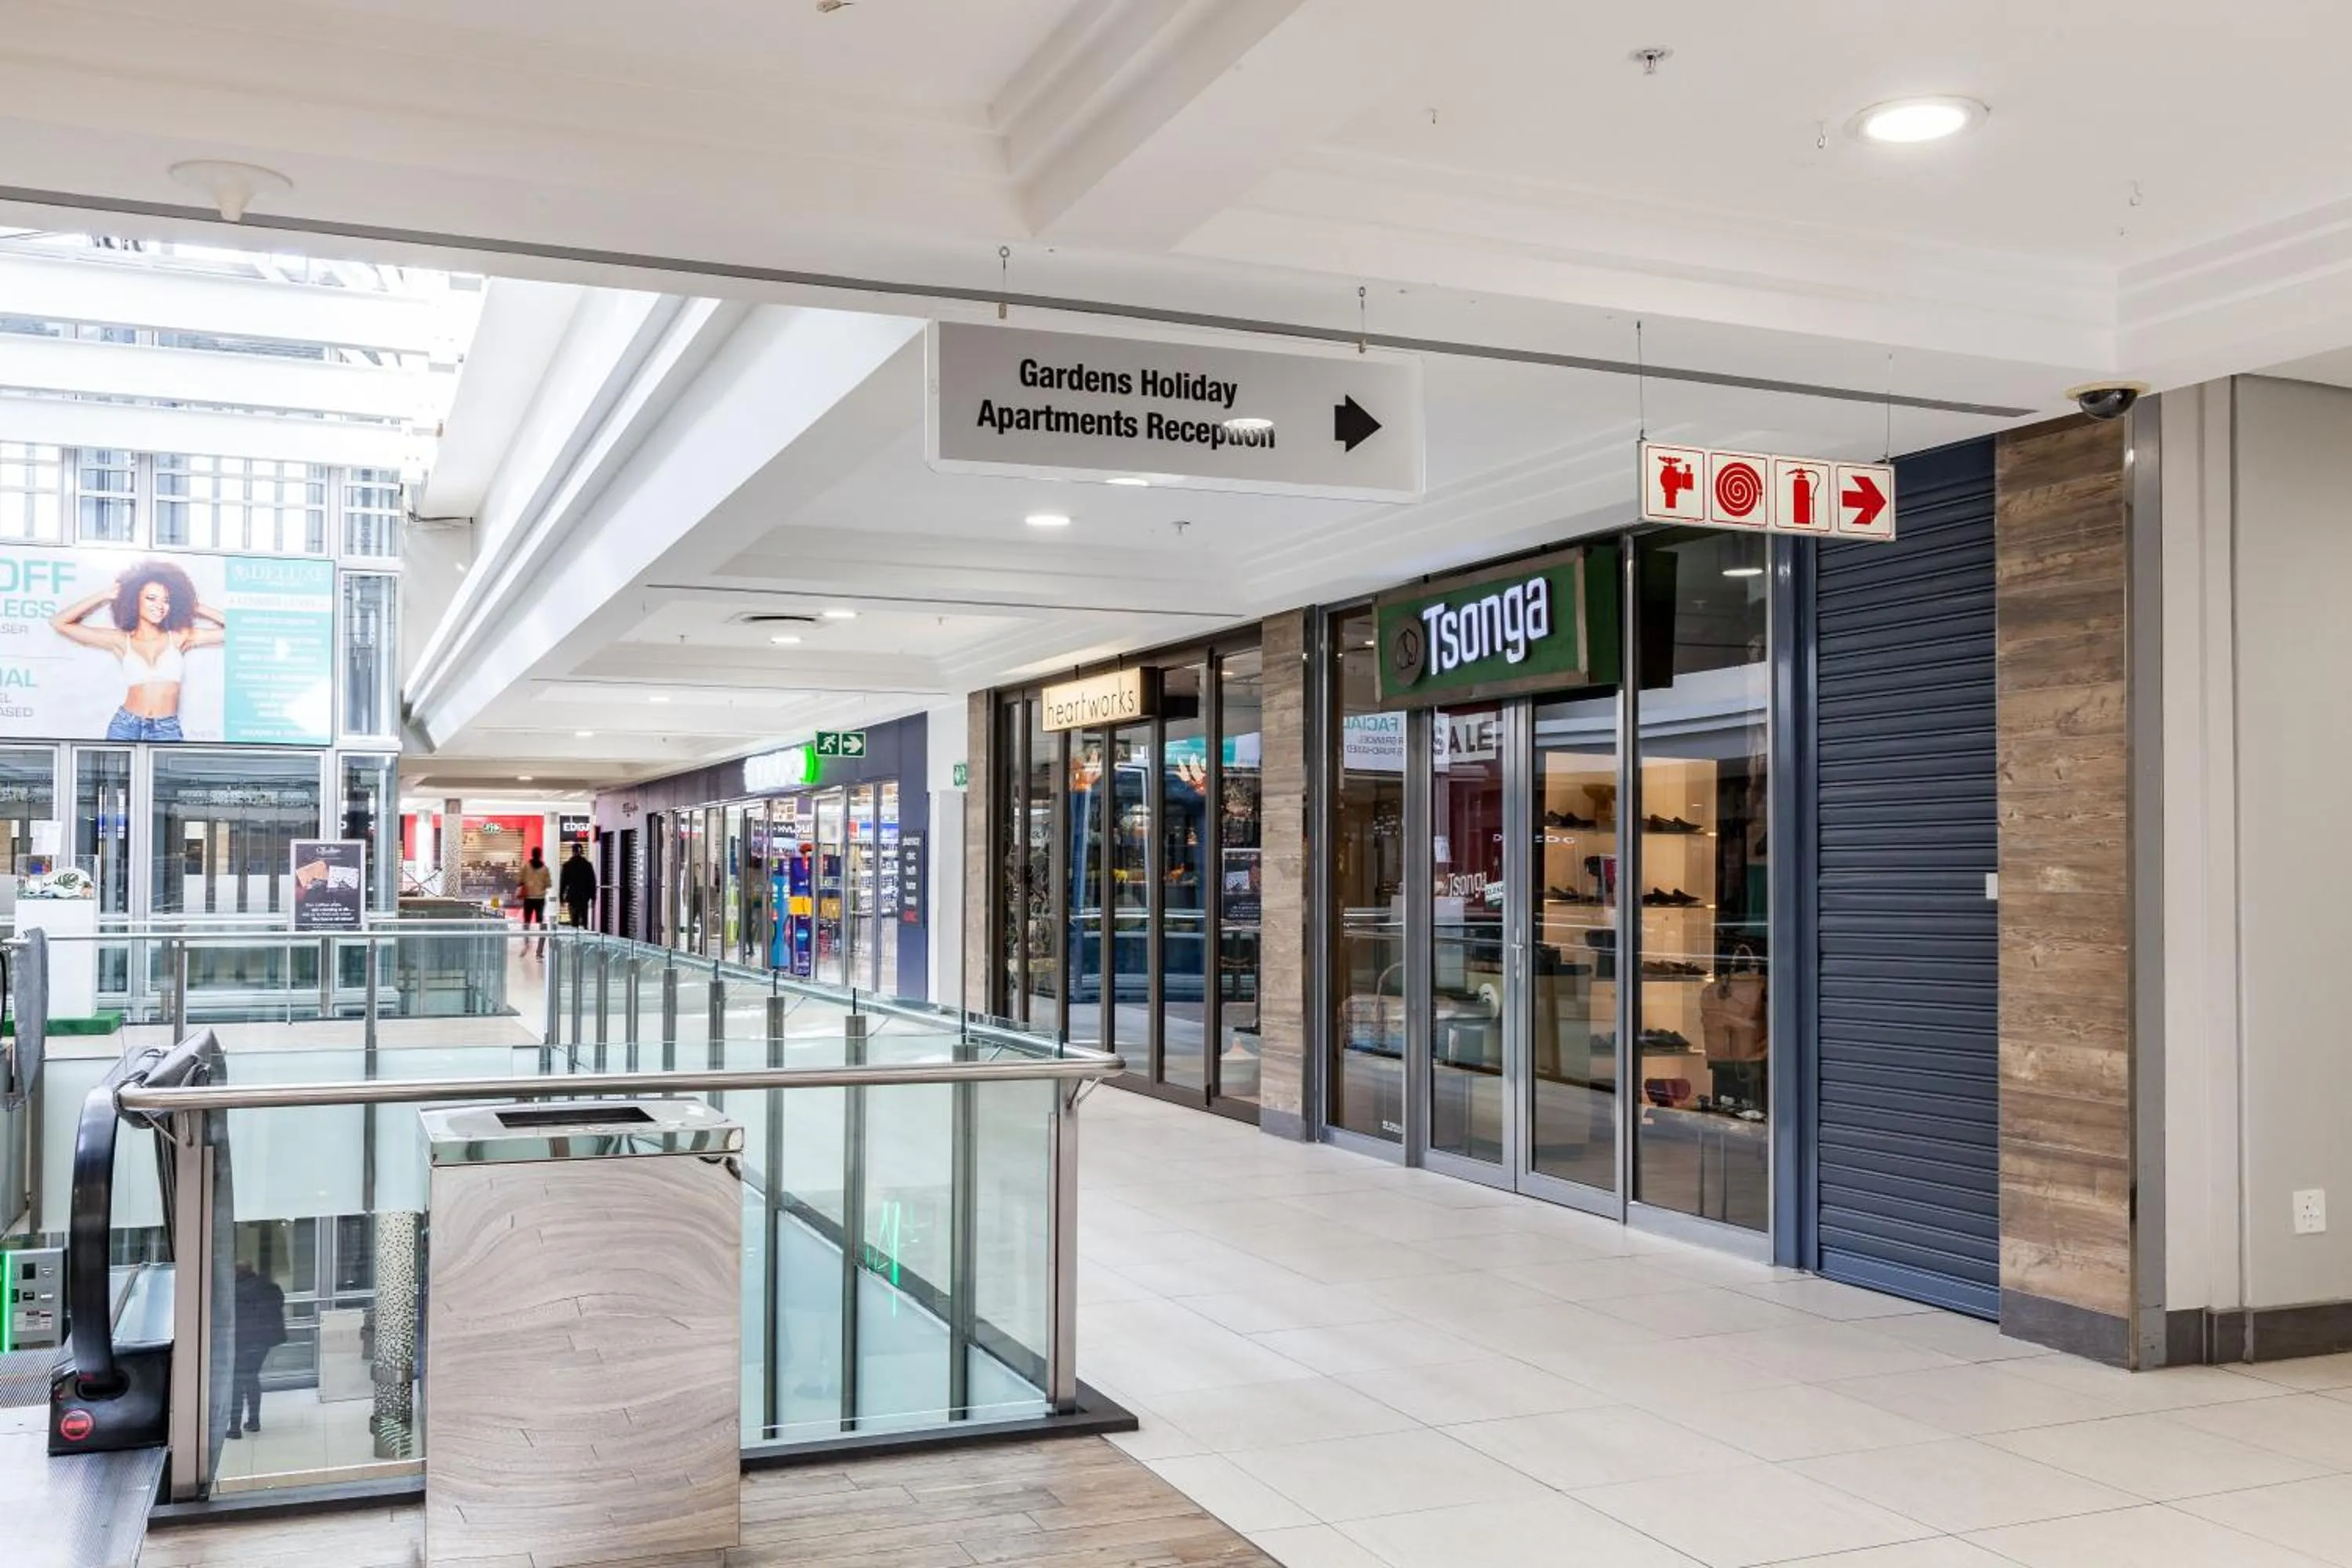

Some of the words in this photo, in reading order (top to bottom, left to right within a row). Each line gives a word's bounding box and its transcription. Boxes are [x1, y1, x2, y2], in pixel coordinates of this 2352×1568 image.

[1019, 358, 1132, 395] Gardens
[1141, 369, 1237, 409] Holiday
[977, 398, 1138, 437] Apartments
[0, 598, 58, 619] EGS
[1422, 576, 1550, 676] Tsonga
[1047, 676, 1135, 726] heartworks
[1436, 720, 1496, 754] ALE
